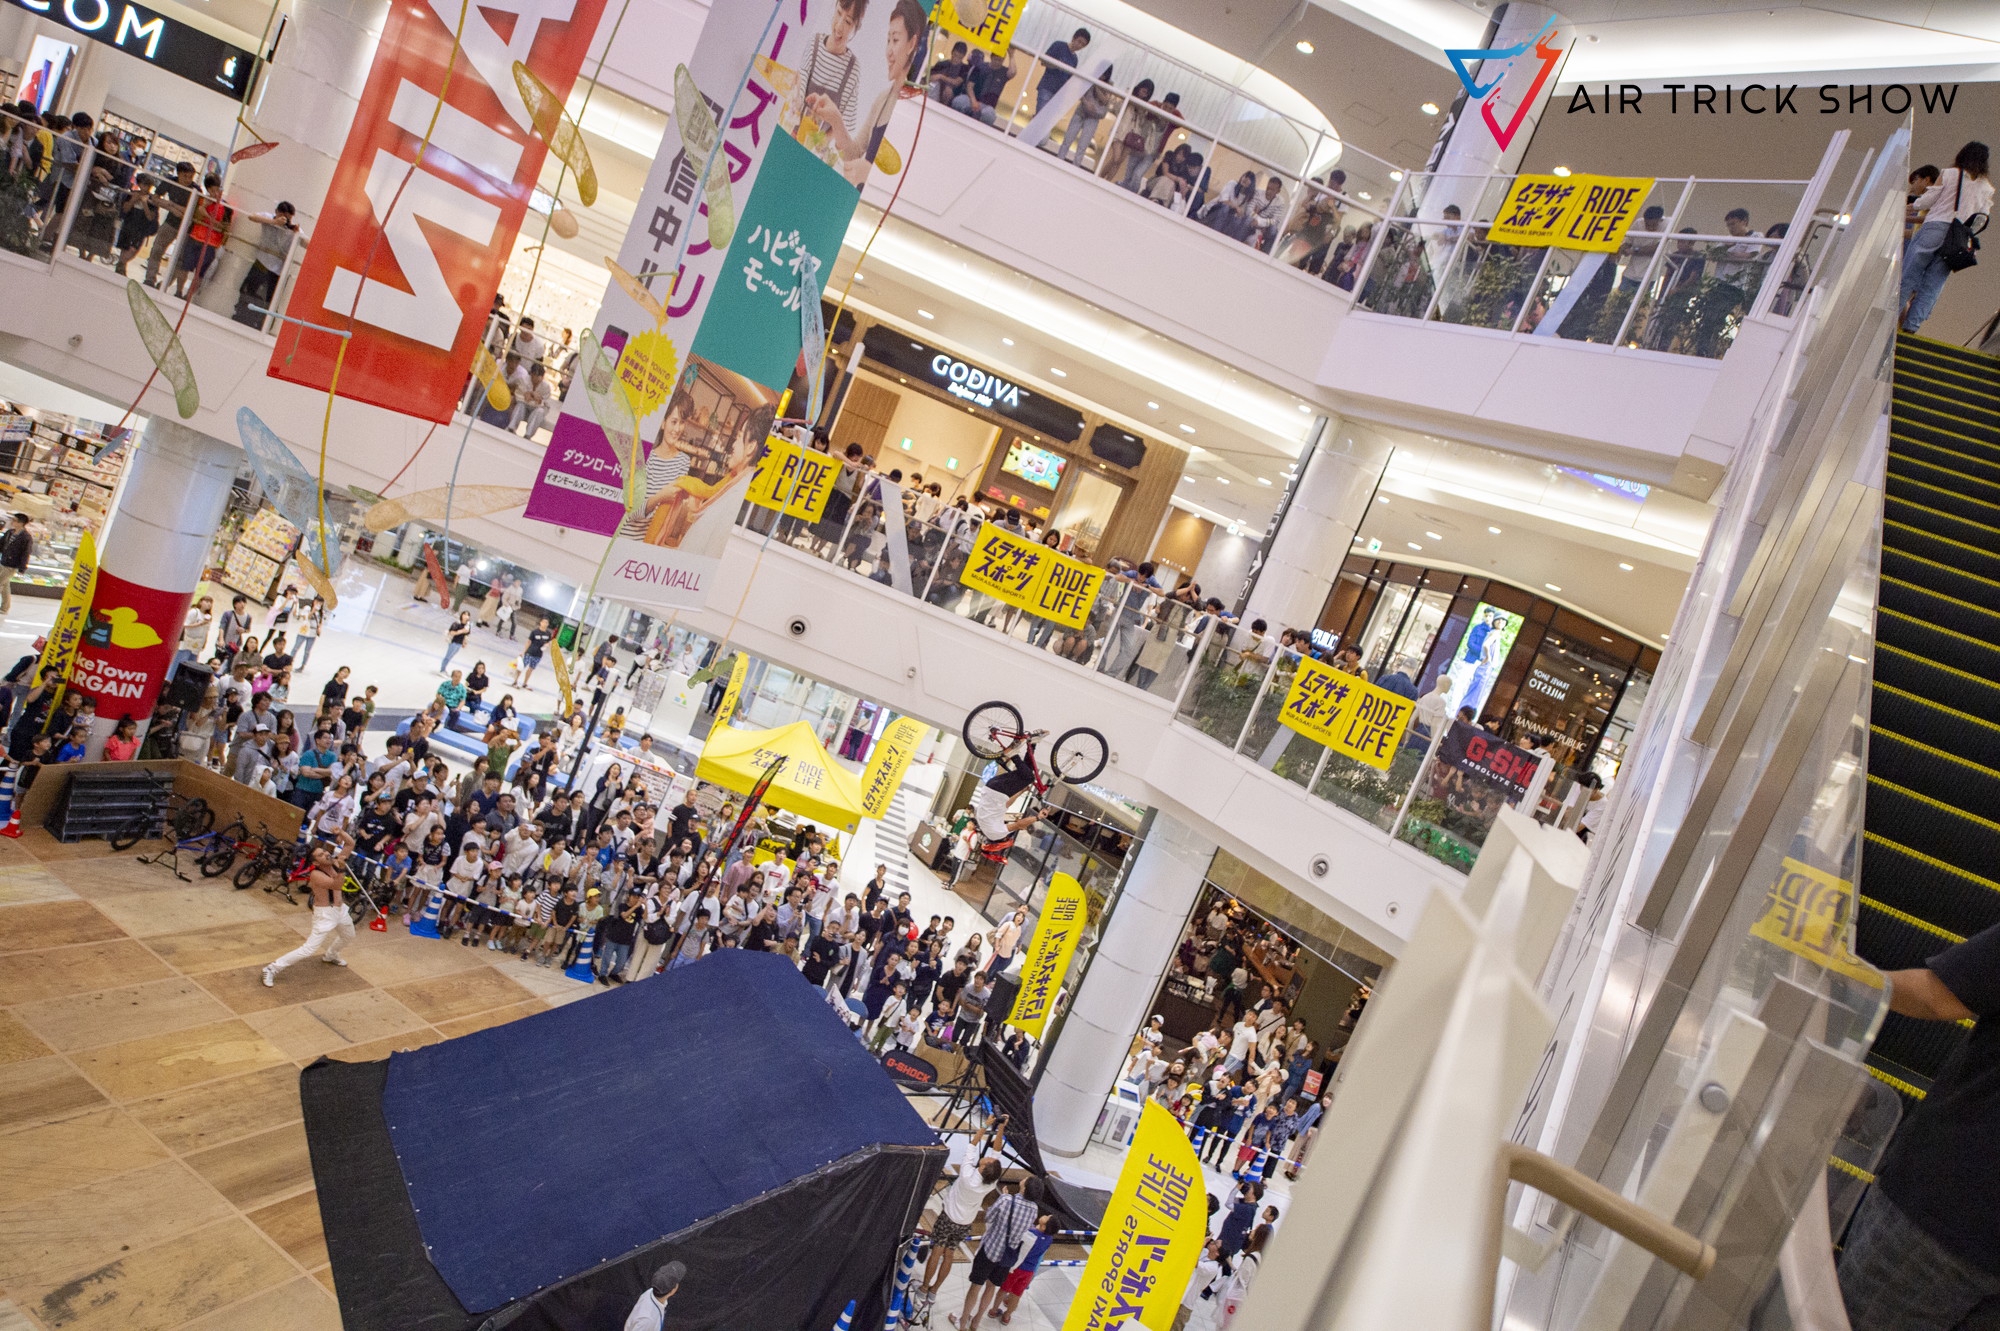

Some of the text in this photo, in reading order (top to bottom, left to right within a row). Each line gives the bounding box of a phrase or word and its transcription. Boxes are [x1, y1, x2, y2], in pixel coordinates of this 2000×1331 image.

[20, 0, 165, 59] OM
[1515, 183, 1576, 205] ムラサキ
[1582, 185, 1641, 215] RIDE
[1503, 205, 1566, 229] スポーツ
[1567, 214, 1625, 242] LIFE
[932, 354, 1019, 408] GODIVA
[562, 448, 623, 478] ダウンロード
[781, 453, 832, 488] RIDE
[771, 477, 821, 512] LFE
[983, 536, 1041, 570] ムラサキ
[661, 567, 701, 591] MALL
[971, 573, 1026, 600] MURASAKI SPORTS
[974, 555, 1034, 592] スポーツ
[1049, 562, 1096, 596] RIDE
[1039, 586, 1087, 620] LIFE
[74, 652, 148, 683] keTown
[1298, 669, 1351, 704] ムラサキ
[1289, 691, 1342, 727] スポーツ
[1355, 692, 1406, 731] RIDE
[894, 723, 910, 741] RIDE
[903, 726, 919, 745] LIFE
[1343, 719, 1393, 759] LIFE
[1514, 715, 1587, 753] BANANA REPUBLIC
[798, 760, 826, 780] RIDE
[862, 744, 899, 811] ムラサキスポーツ
[1461, 758, 1511, 787] ABSOLUTE
[871, 778, 894, 815] MURASAKI
[886, 1058, 931, 1083] G-SHOCK
